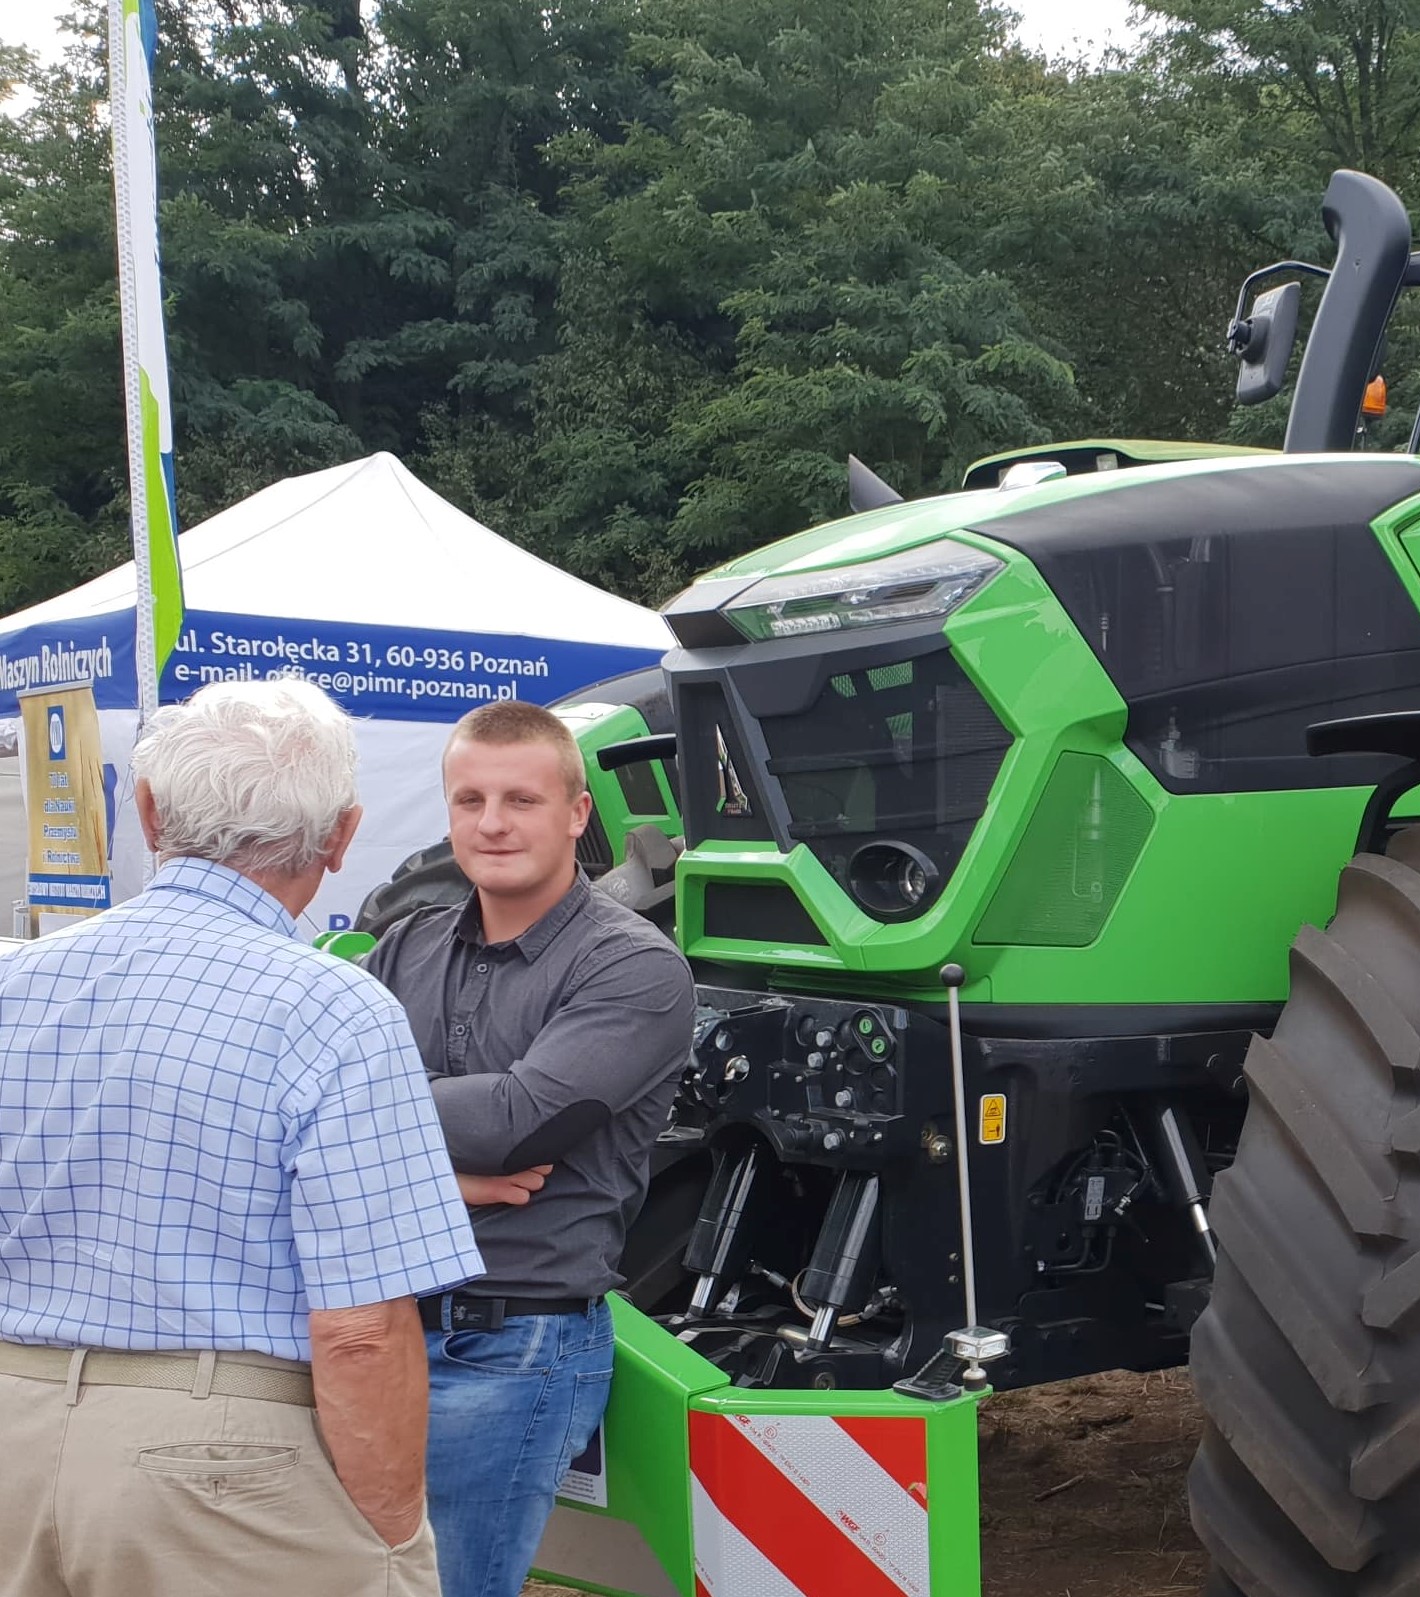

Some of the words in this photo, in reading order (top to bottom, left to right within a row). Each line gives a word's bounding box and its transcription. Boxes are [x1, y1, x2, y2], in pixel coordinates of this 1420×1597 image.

[41, 635, 113, 683] Rolniczych
[174, 629, 205, 652] ul.
[210, 631, 339, 664] Starołęcka
[346, 641, 382, 668] 31,
[386, 645, 465, 671] 60-936
[470, 651, 549, 677] Poznań
[174, 662, 260, 683] e-mail:
